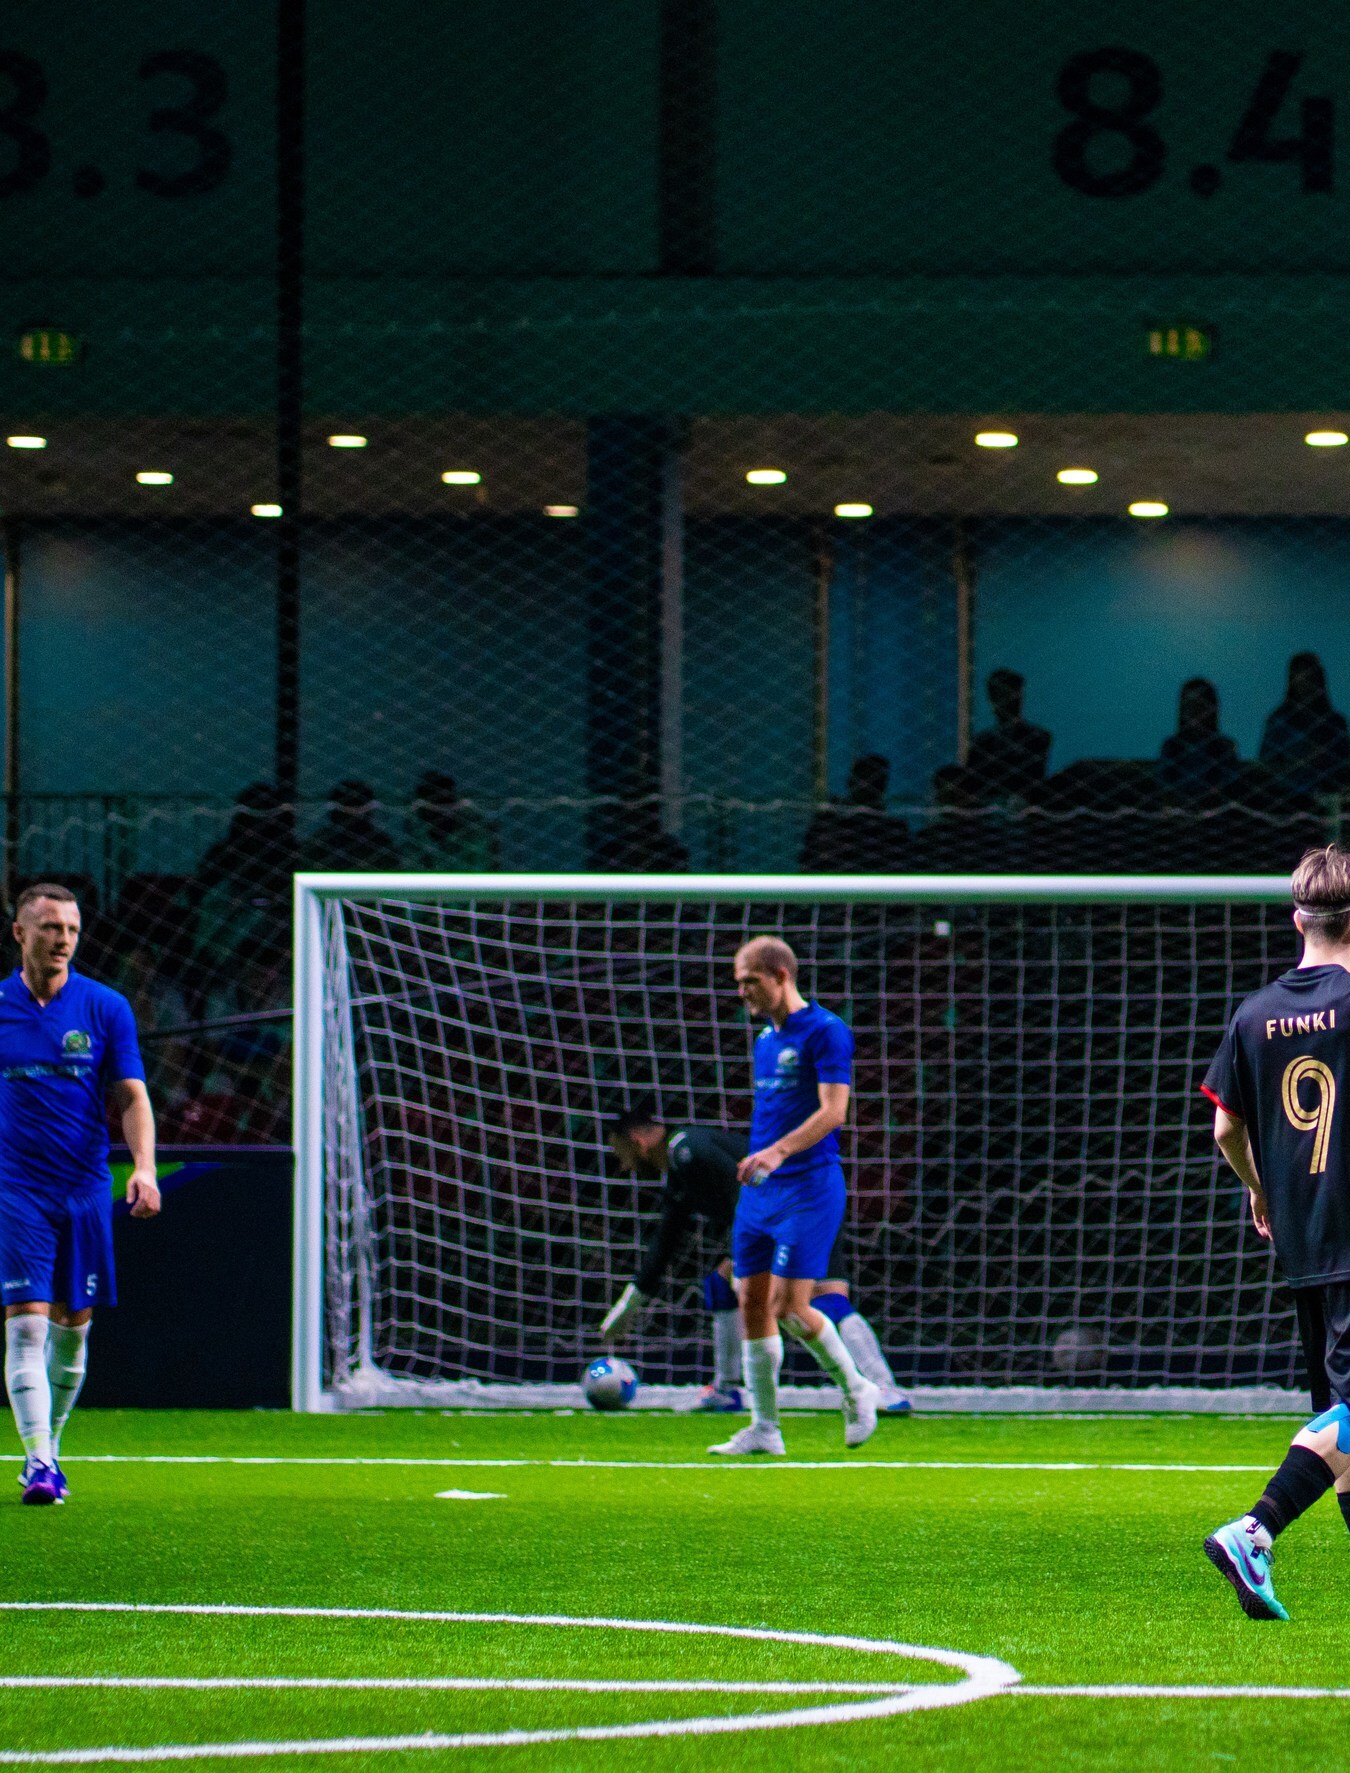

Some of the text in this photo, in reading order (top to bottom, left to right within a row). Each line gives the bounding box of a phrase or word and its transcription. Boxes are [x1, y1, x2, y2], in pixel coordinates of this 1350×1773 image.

[1054, 48, 1333, 197] 8.4
[1266, 1009, 1336, 1040] FUNKI
[1282, 1055, 1336, 1175] 9
[86, 1273, 98, 1297] 5
